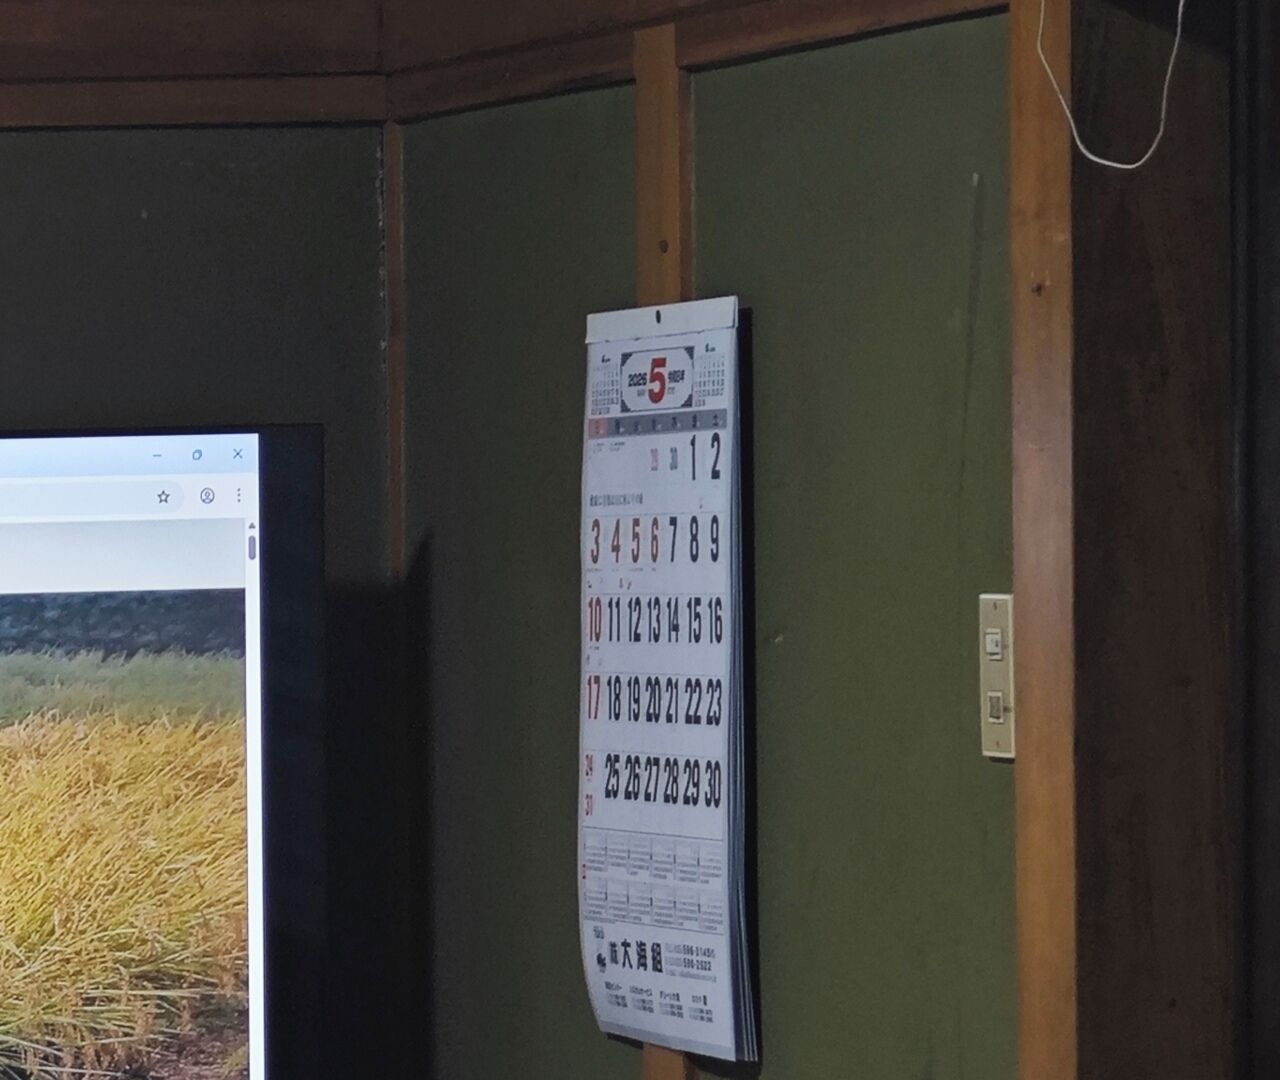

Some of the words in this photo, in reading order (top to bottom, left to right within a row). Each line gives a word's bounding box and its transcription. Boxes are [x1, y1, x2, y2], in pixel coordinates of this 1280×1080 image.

[648, 357, 666, 404] 5
[690, 434, 696, 481] 1
[711, 432, 720, 480] 2
[591, 518, 601, 564] 3
[611, 518, 621, 563] 4
[631, 517, 641, 563] 5
[650, 517, 659, 563] 6
[669, 517, 678, 562] 7
[690, 515, 699, 563] 8
[710, 515, 719, 562] 9
[588, 597, 602, 642] 10
[608, 597, 621, 642] 11
[627, 597, 641, 642] 12
[647, 597, 661, 643] 13
[667, 597, 680, 643] 14
[687, 597, 702, 643] 15
[707, 597, 723, 644] 16
[587, 675, 600, 720] 17
[607, 675, 621, 721] 18
[627, 676, 641, 722] 19
[645, 676, 661, 723] 20
[665, 677, 679, 724] 21
[685, 678, 702, 725] 22
[706, 678, 722, 726] 23
[605, 753, 620, 799] 25
[624, 754, 640, 801] 26
[644, 756, 660, 802] 27
[663, 757, 679, 805] 28
[683, 758, 699, 807] 29
[705, 760, 721, 808] 30
